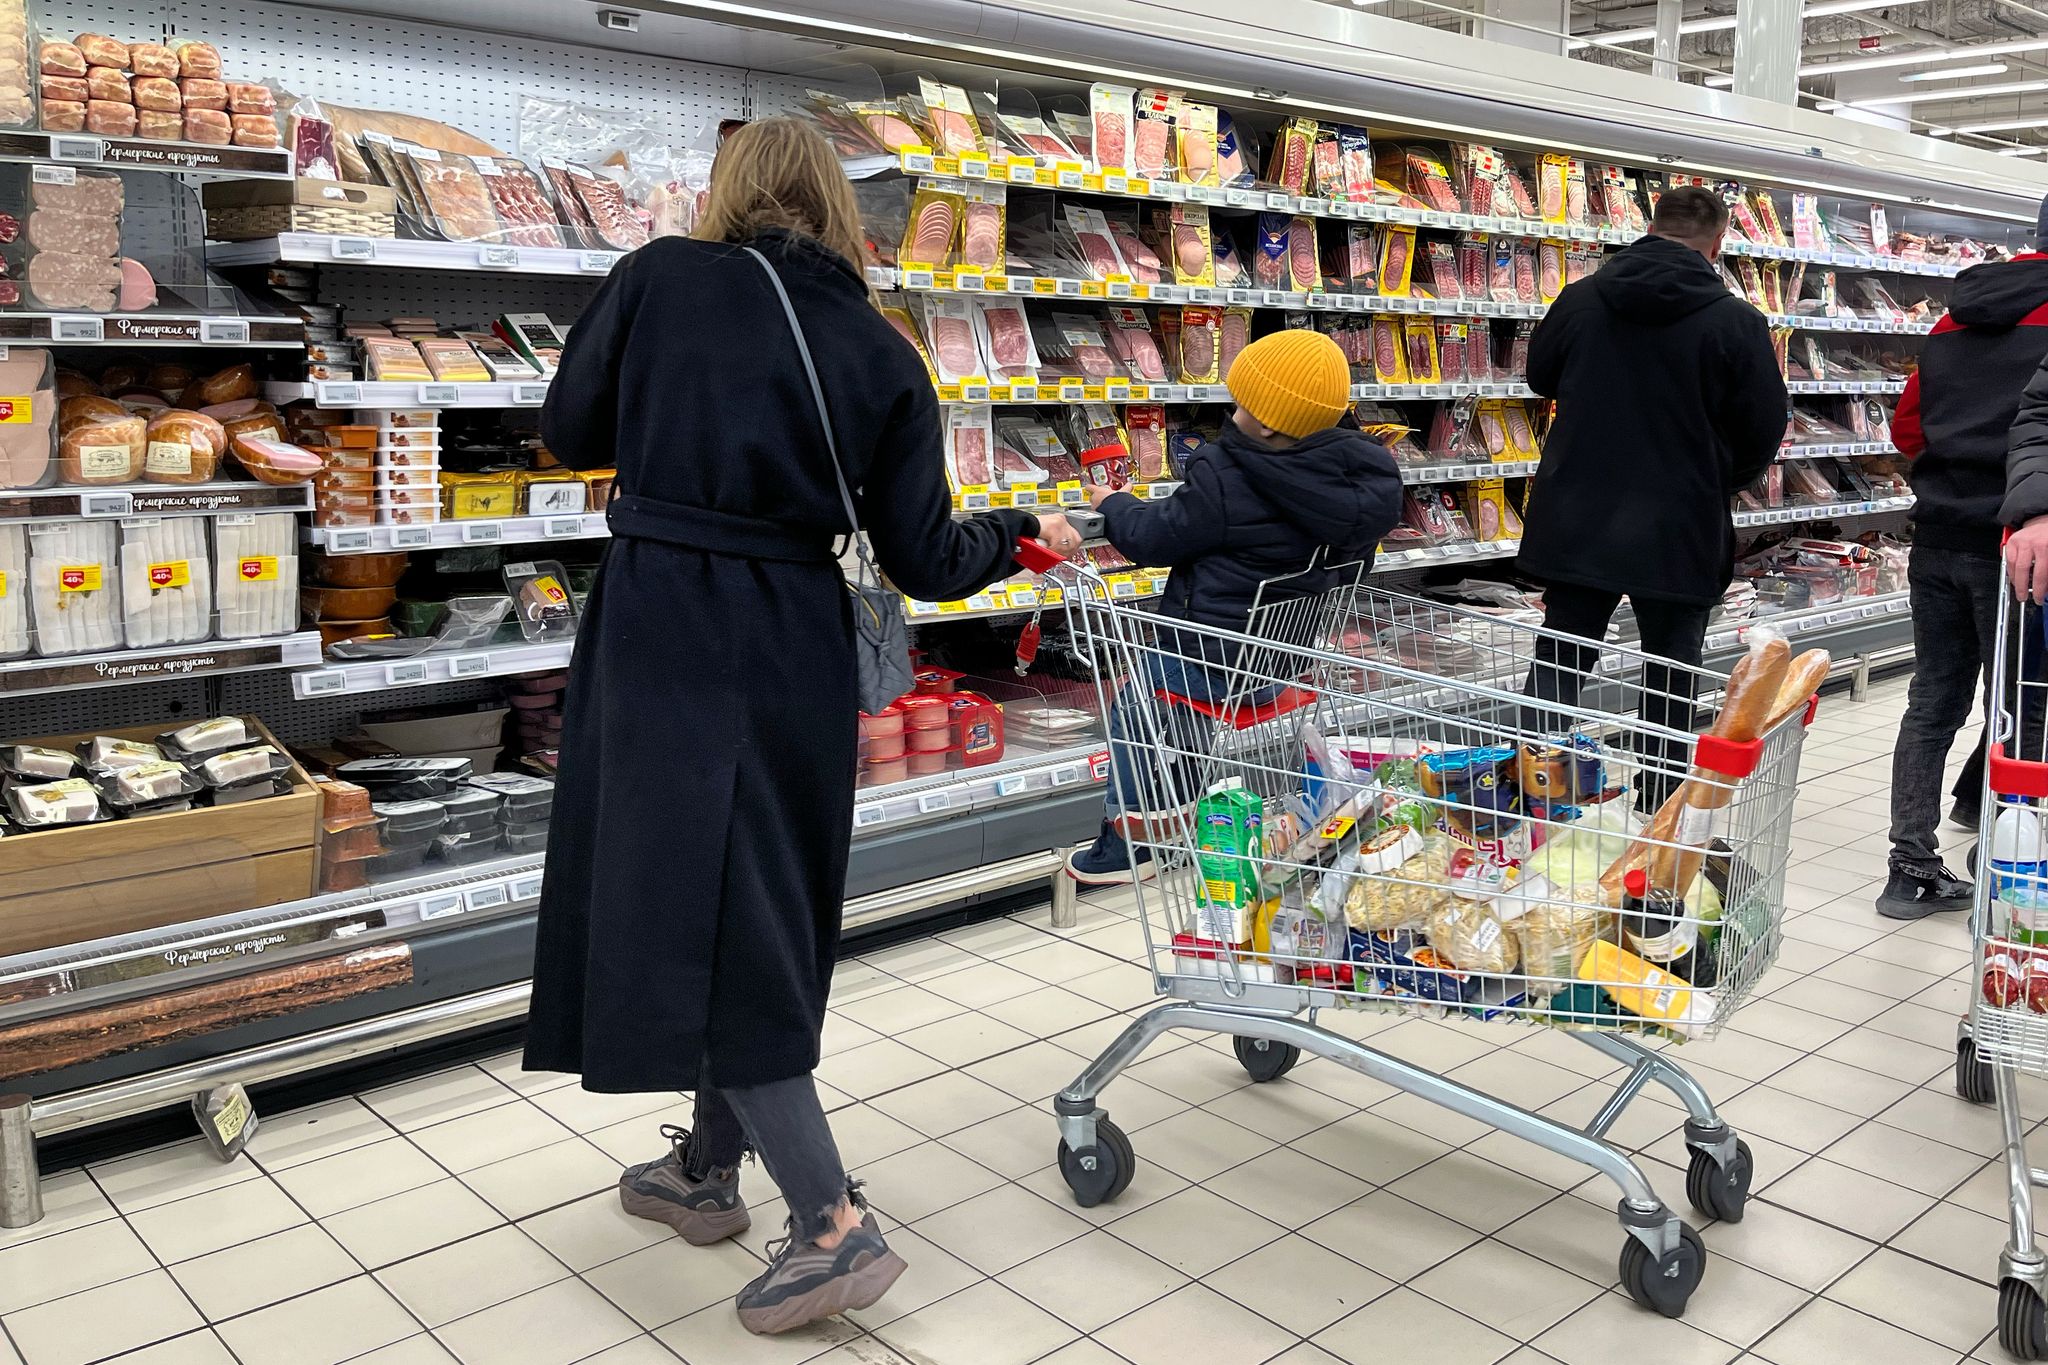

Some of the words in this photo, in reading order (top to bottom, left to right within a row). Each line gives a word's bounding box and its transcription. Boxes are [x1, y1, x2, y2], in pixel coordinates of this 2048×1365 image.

[168, 152, 221, 167] продукты
[117, 319, 184, 338] Фермерские
[133, 497, 188, 511] ермерские
[189, 495, 242, 510] продукты
[152, 573, 173, 581] -40%
[95, 662, 161, 679] Фермерские
[163, 657, 216, 673] продукты
[164, 945, 232, 967] Фермерские
[234, 933, 287, 955] продукты
